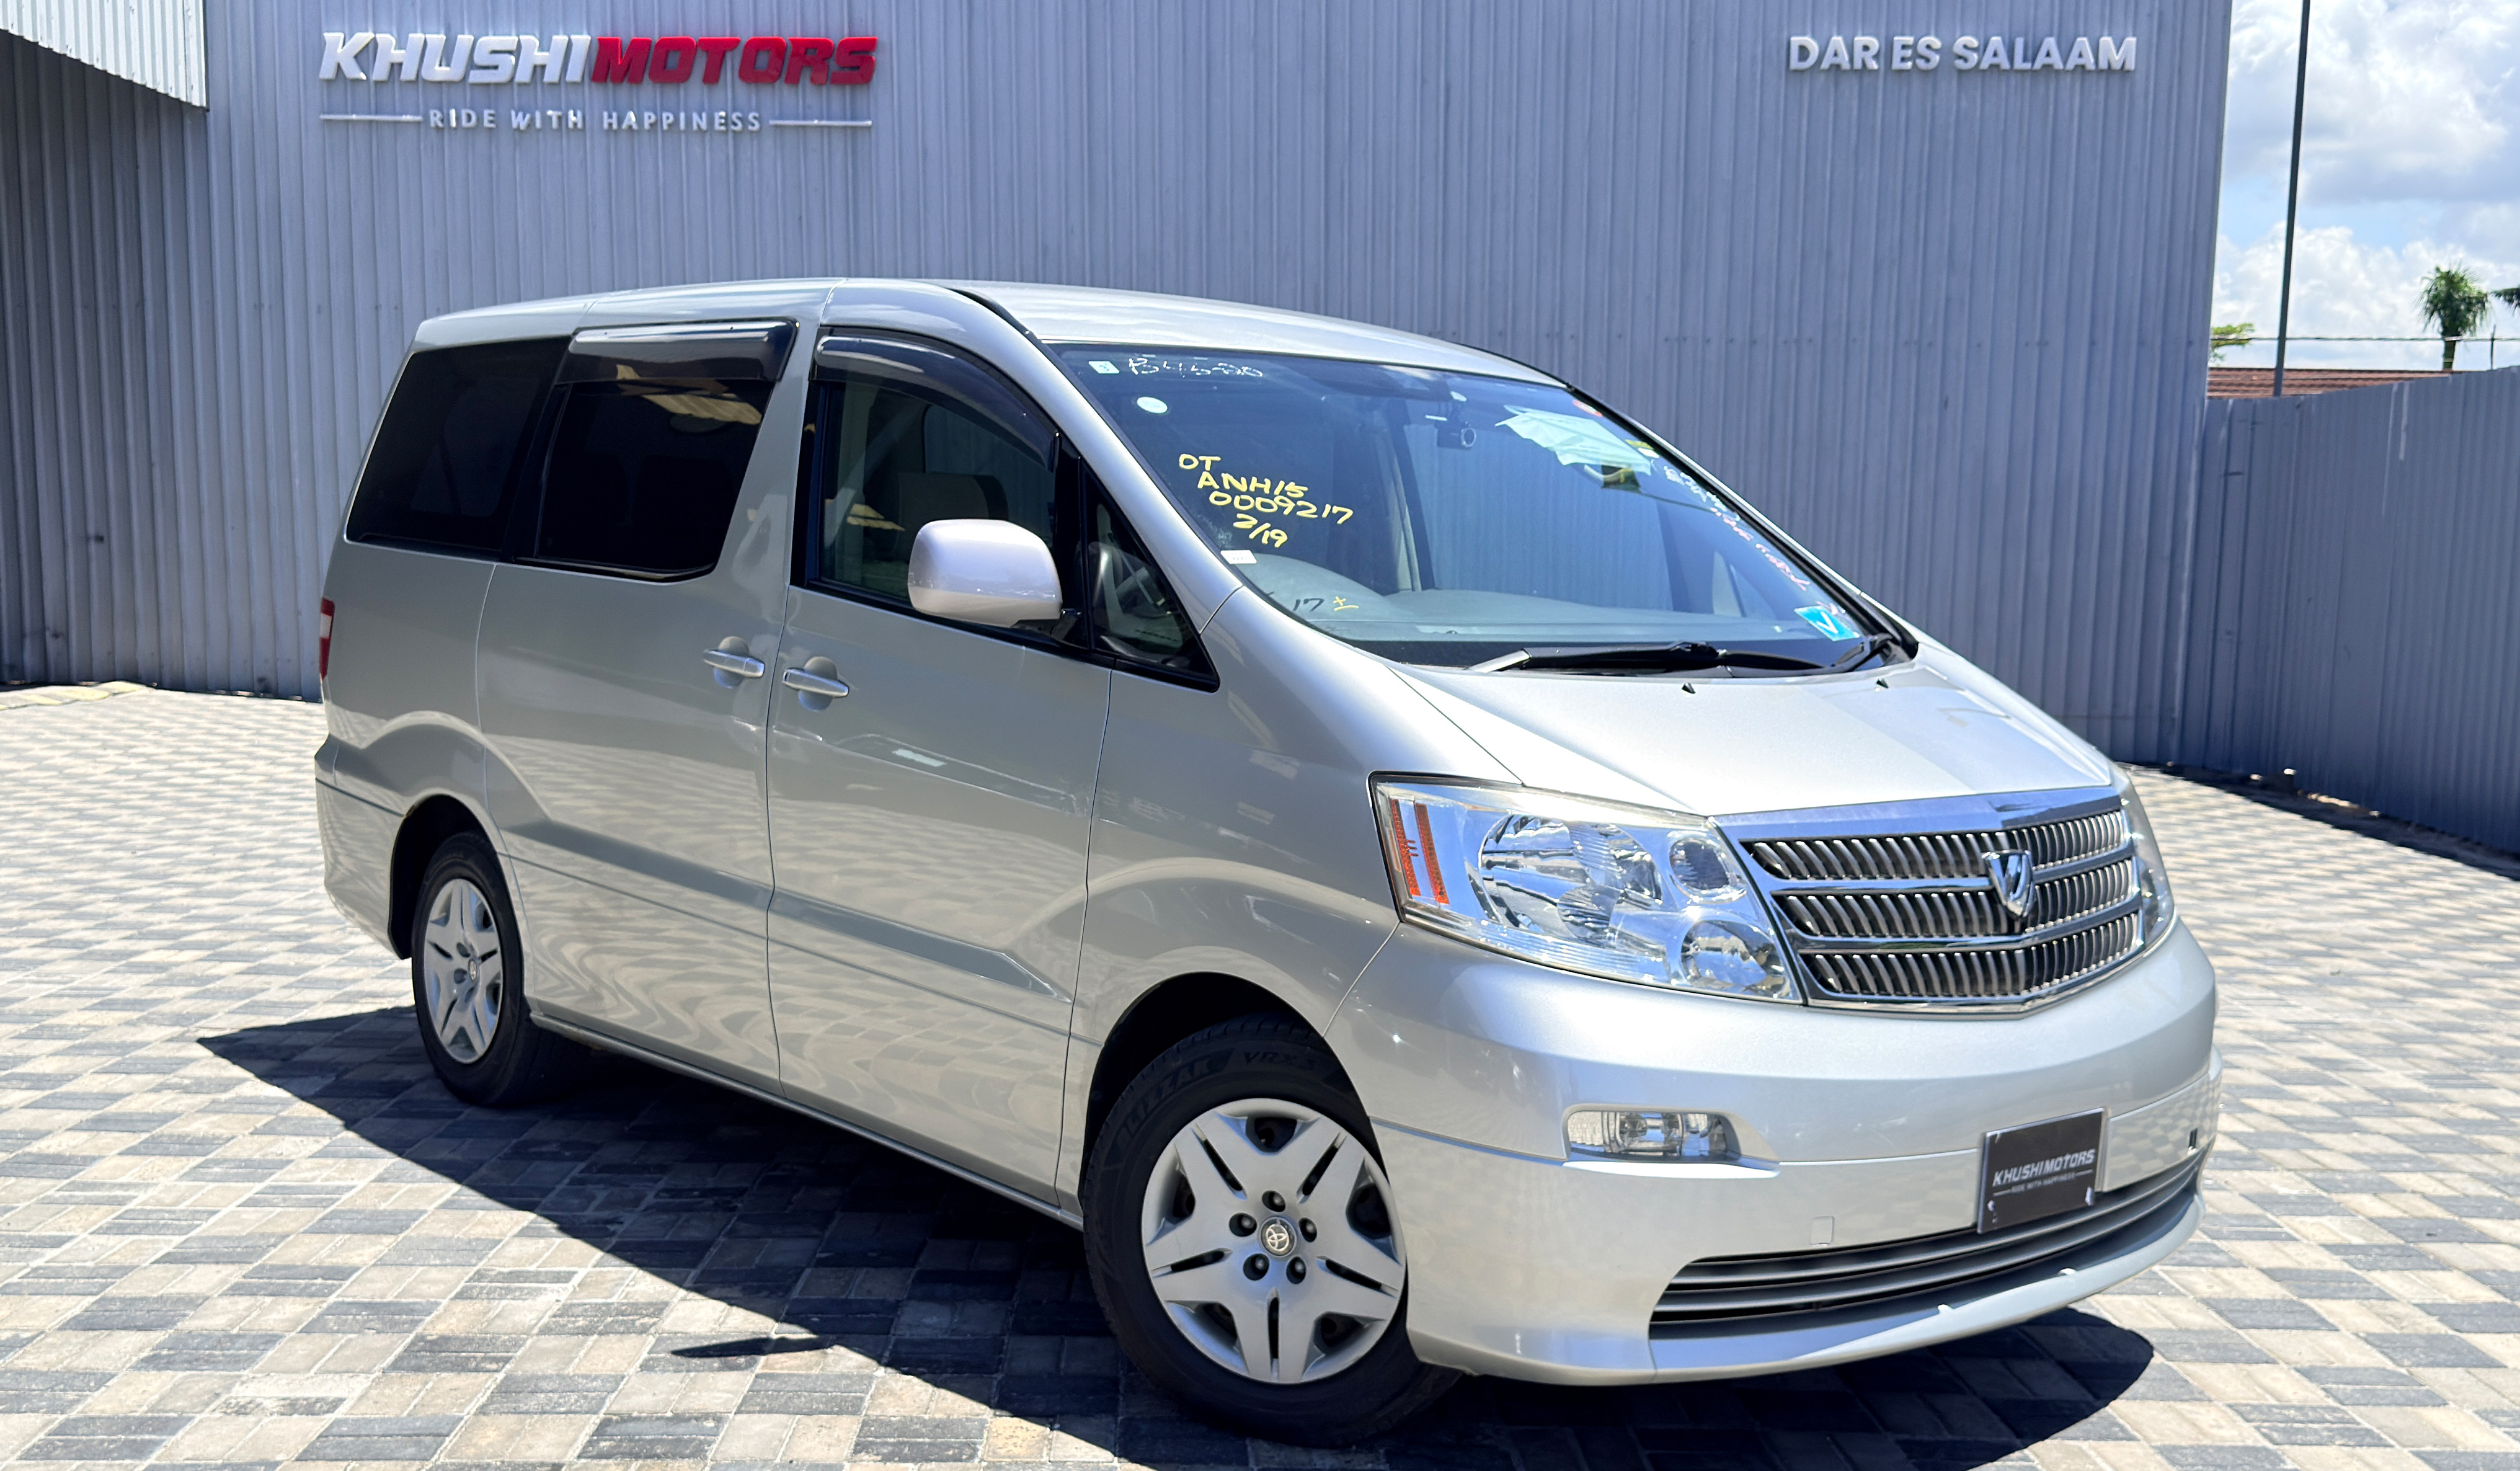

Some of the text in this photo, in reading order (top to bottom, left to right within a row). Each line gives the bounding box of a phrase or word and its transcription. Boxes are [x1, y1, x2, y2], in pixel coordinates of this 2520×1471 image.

[1789, 35, 2137, 72] DAR ES SALAAM
[429, 108, 761, 132] RIDE WITH HAPPINESS
[1197, 471, 1308, 497] ANH15
[1209, 491, 1354, 524] 0009217
[1233, 513, 1288, 548] 2/19
